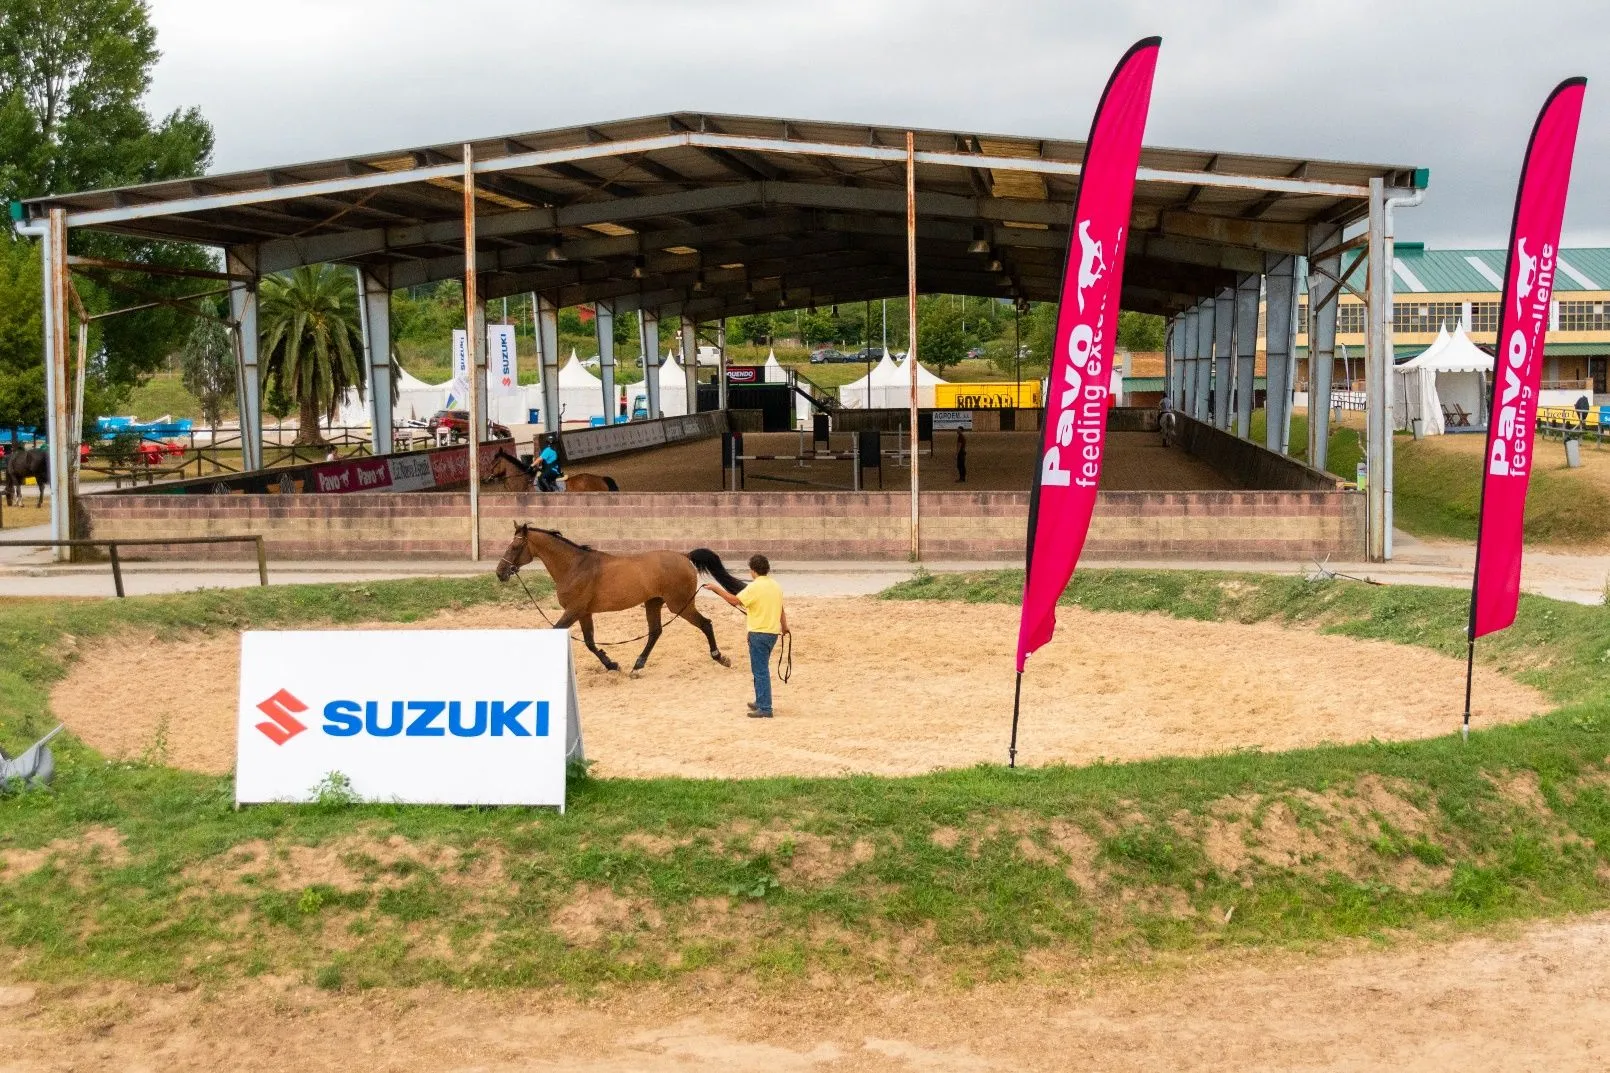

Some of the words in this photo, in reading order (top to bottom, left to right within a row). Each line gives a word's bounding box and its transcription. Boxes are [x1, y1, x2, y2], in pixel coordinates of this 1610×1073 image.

[500, 333, 510, 375] SUZUKI
[1041, 324, 1094, 487] Pavo
[1490, 329, 1527, 476] Pavo
[1510, 385, 1532, 477] feeding
[1076, 385, 1107, 488] feeding
[317, 472, 341, 492] Pavo
[356, 467, 377, 486] Pavo
[322, 700, 550, 738] SUZUKI
